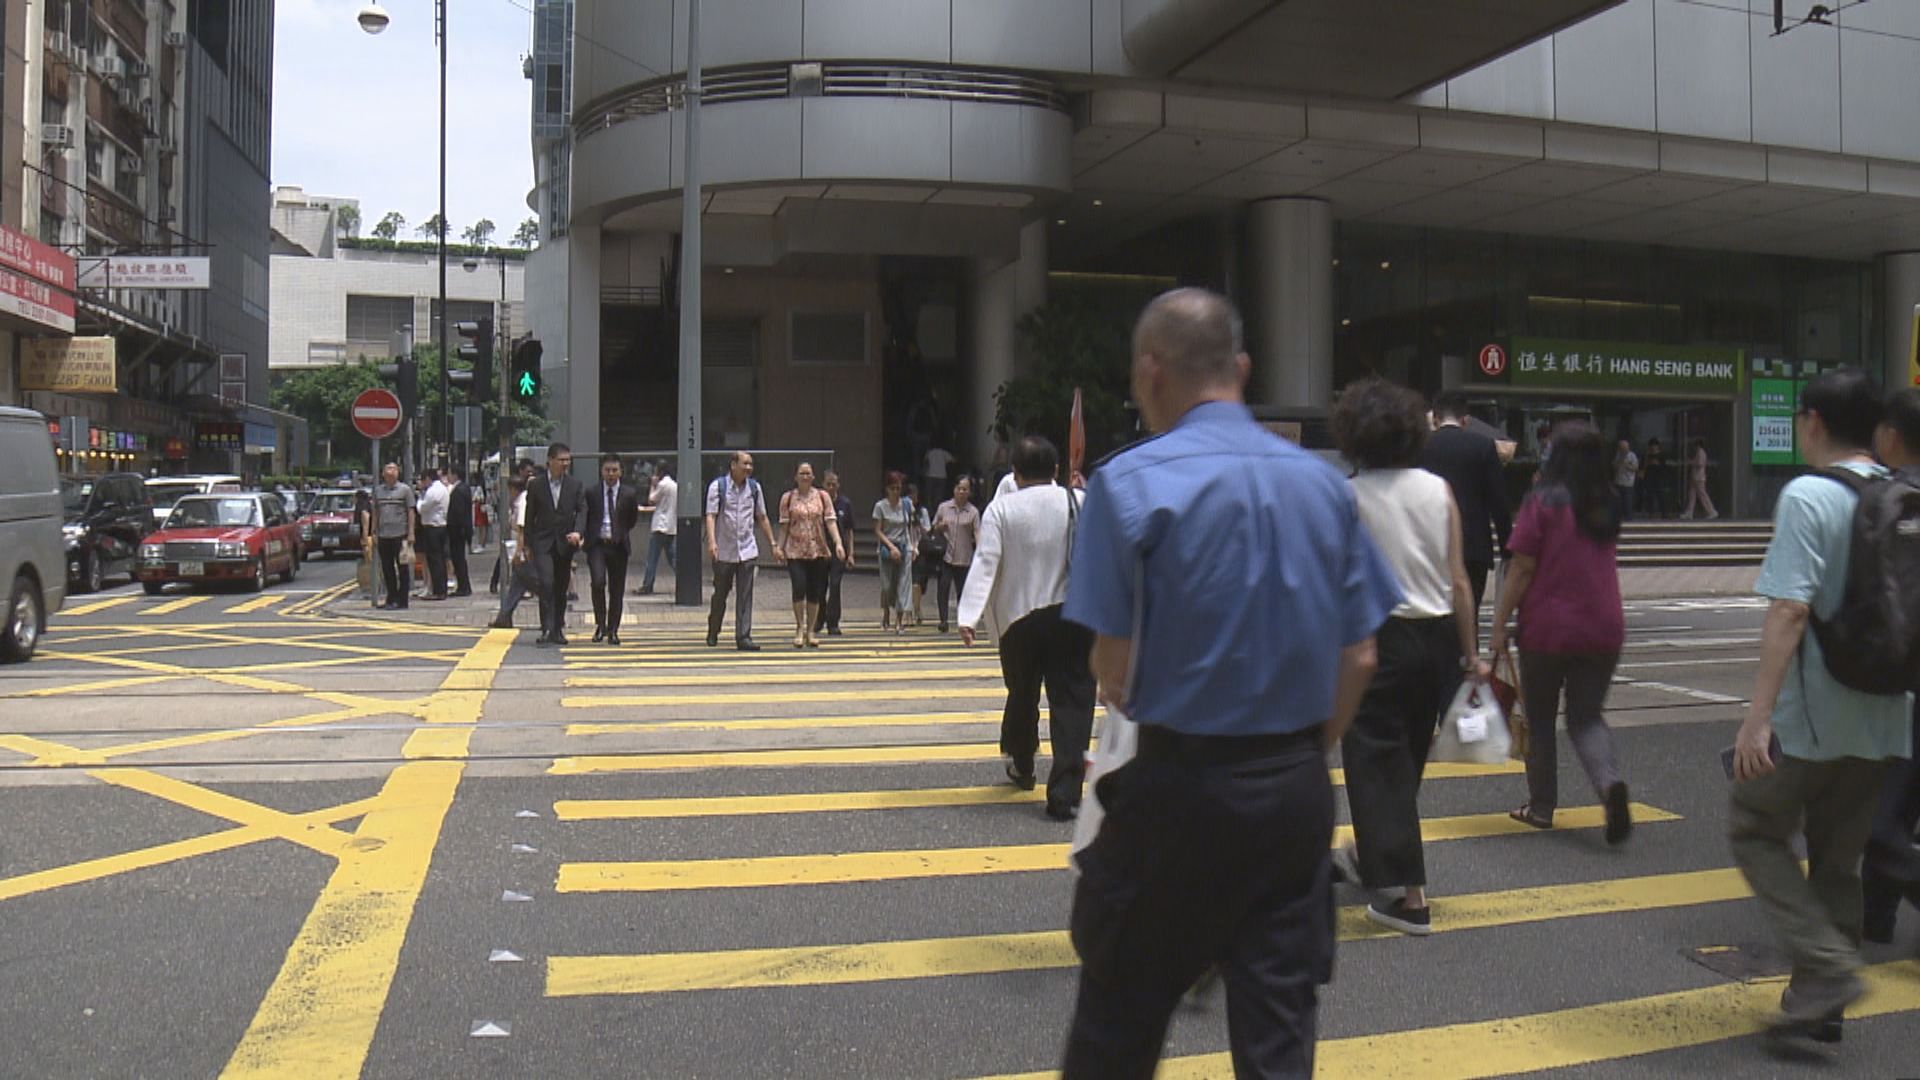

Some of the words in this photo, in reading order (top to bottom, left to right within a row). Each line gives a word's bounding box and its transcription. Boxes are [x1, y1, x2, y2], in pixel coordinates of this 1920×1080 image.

[1610, 357, 1650, 375] HANG
[1654, 359, 1692, 377] SENG
[1696, 361, 1733, 379] BANK
